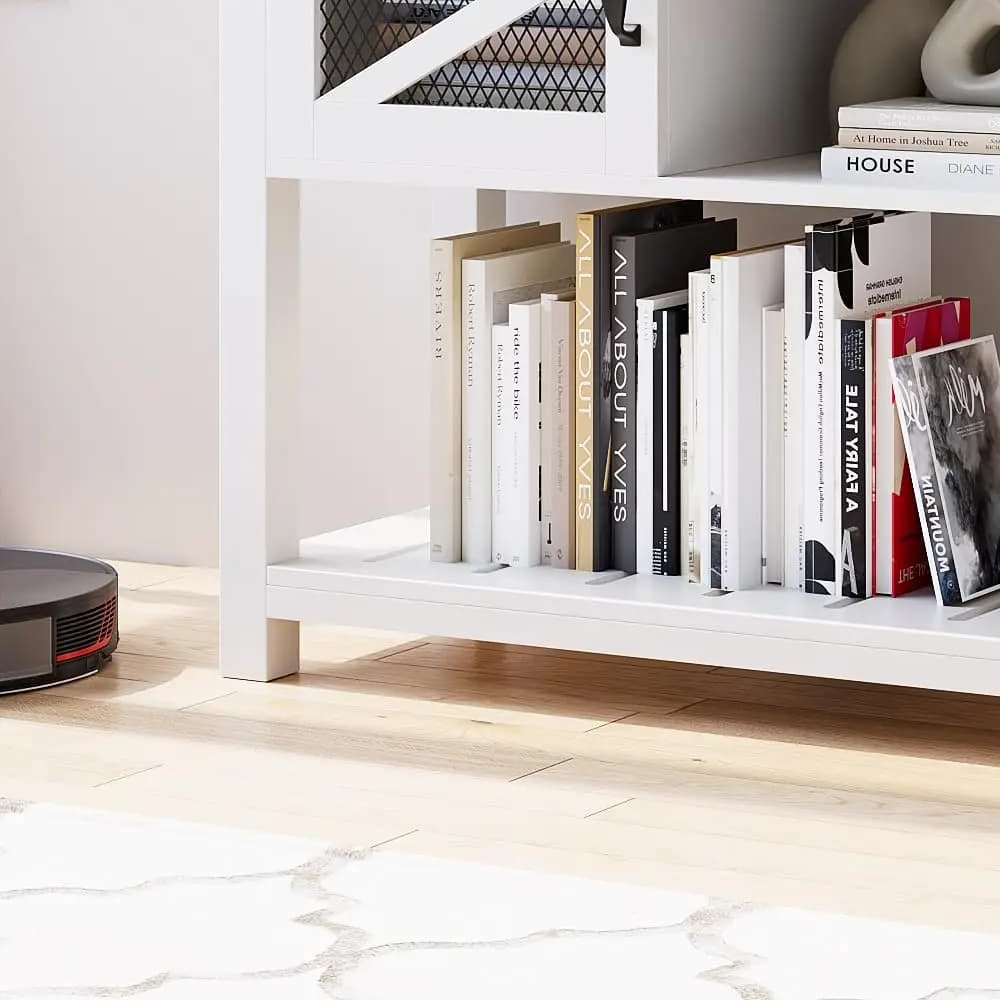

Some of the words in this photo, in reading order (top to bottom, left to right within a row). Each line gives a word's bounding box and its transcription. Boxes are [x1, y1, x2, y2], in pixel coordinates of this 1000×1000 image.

[847, 156, 915, 174] HOUSE
[853, 134, 865, 143] At
[867, 134, 896, 144] Home
[899, 135, 909, 145] in
[911, 136, 944, 147] Joshua
[946, 137, 969, 147] Tree
[948, 163, 994, 177] DIANE
[578, 229, 593, 289] ALL
[613, 249, 627, 306] ALL
[468, 283, 476, 331] Robert
[467, 336, 476, 388] Ryman
[496, 343, 504, 381] Robert
[578, 310, 593, 418] ABOUT
[613, 319, 627, 429] ABOUT
[578, 440, 593, 521] YVES
[613, 443, 627, 524] YVES
